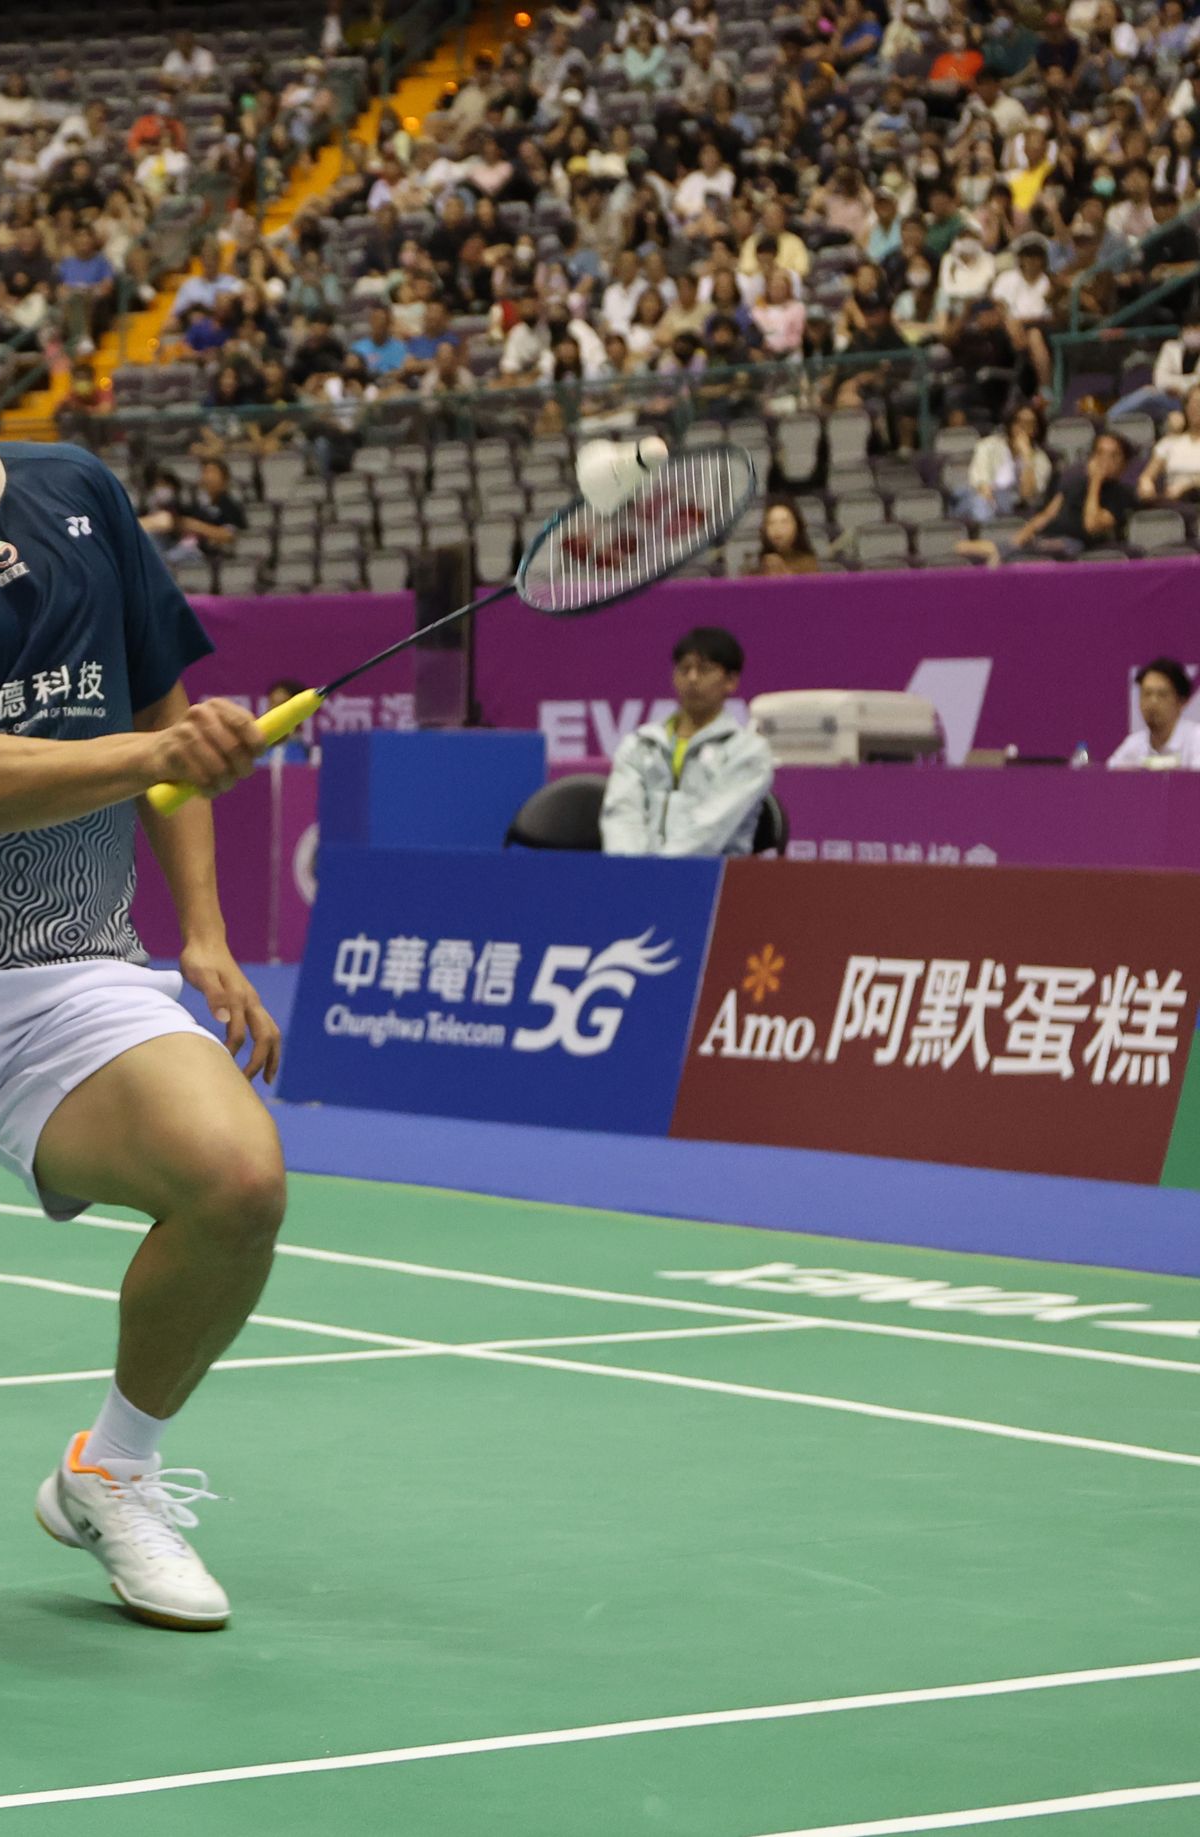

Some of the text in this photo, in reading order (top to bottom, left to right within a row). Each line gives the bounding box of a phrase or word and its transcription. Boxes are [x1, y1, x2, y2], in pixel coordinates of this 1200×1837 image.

[333, 932, 522, 1006] 中華電信
[511, 944, 637, 1057] 5G
[323, 1003, 507, 1048] Chunghwa Telecom
[824, 954, 1188, 1087] 阿默蛋糕
